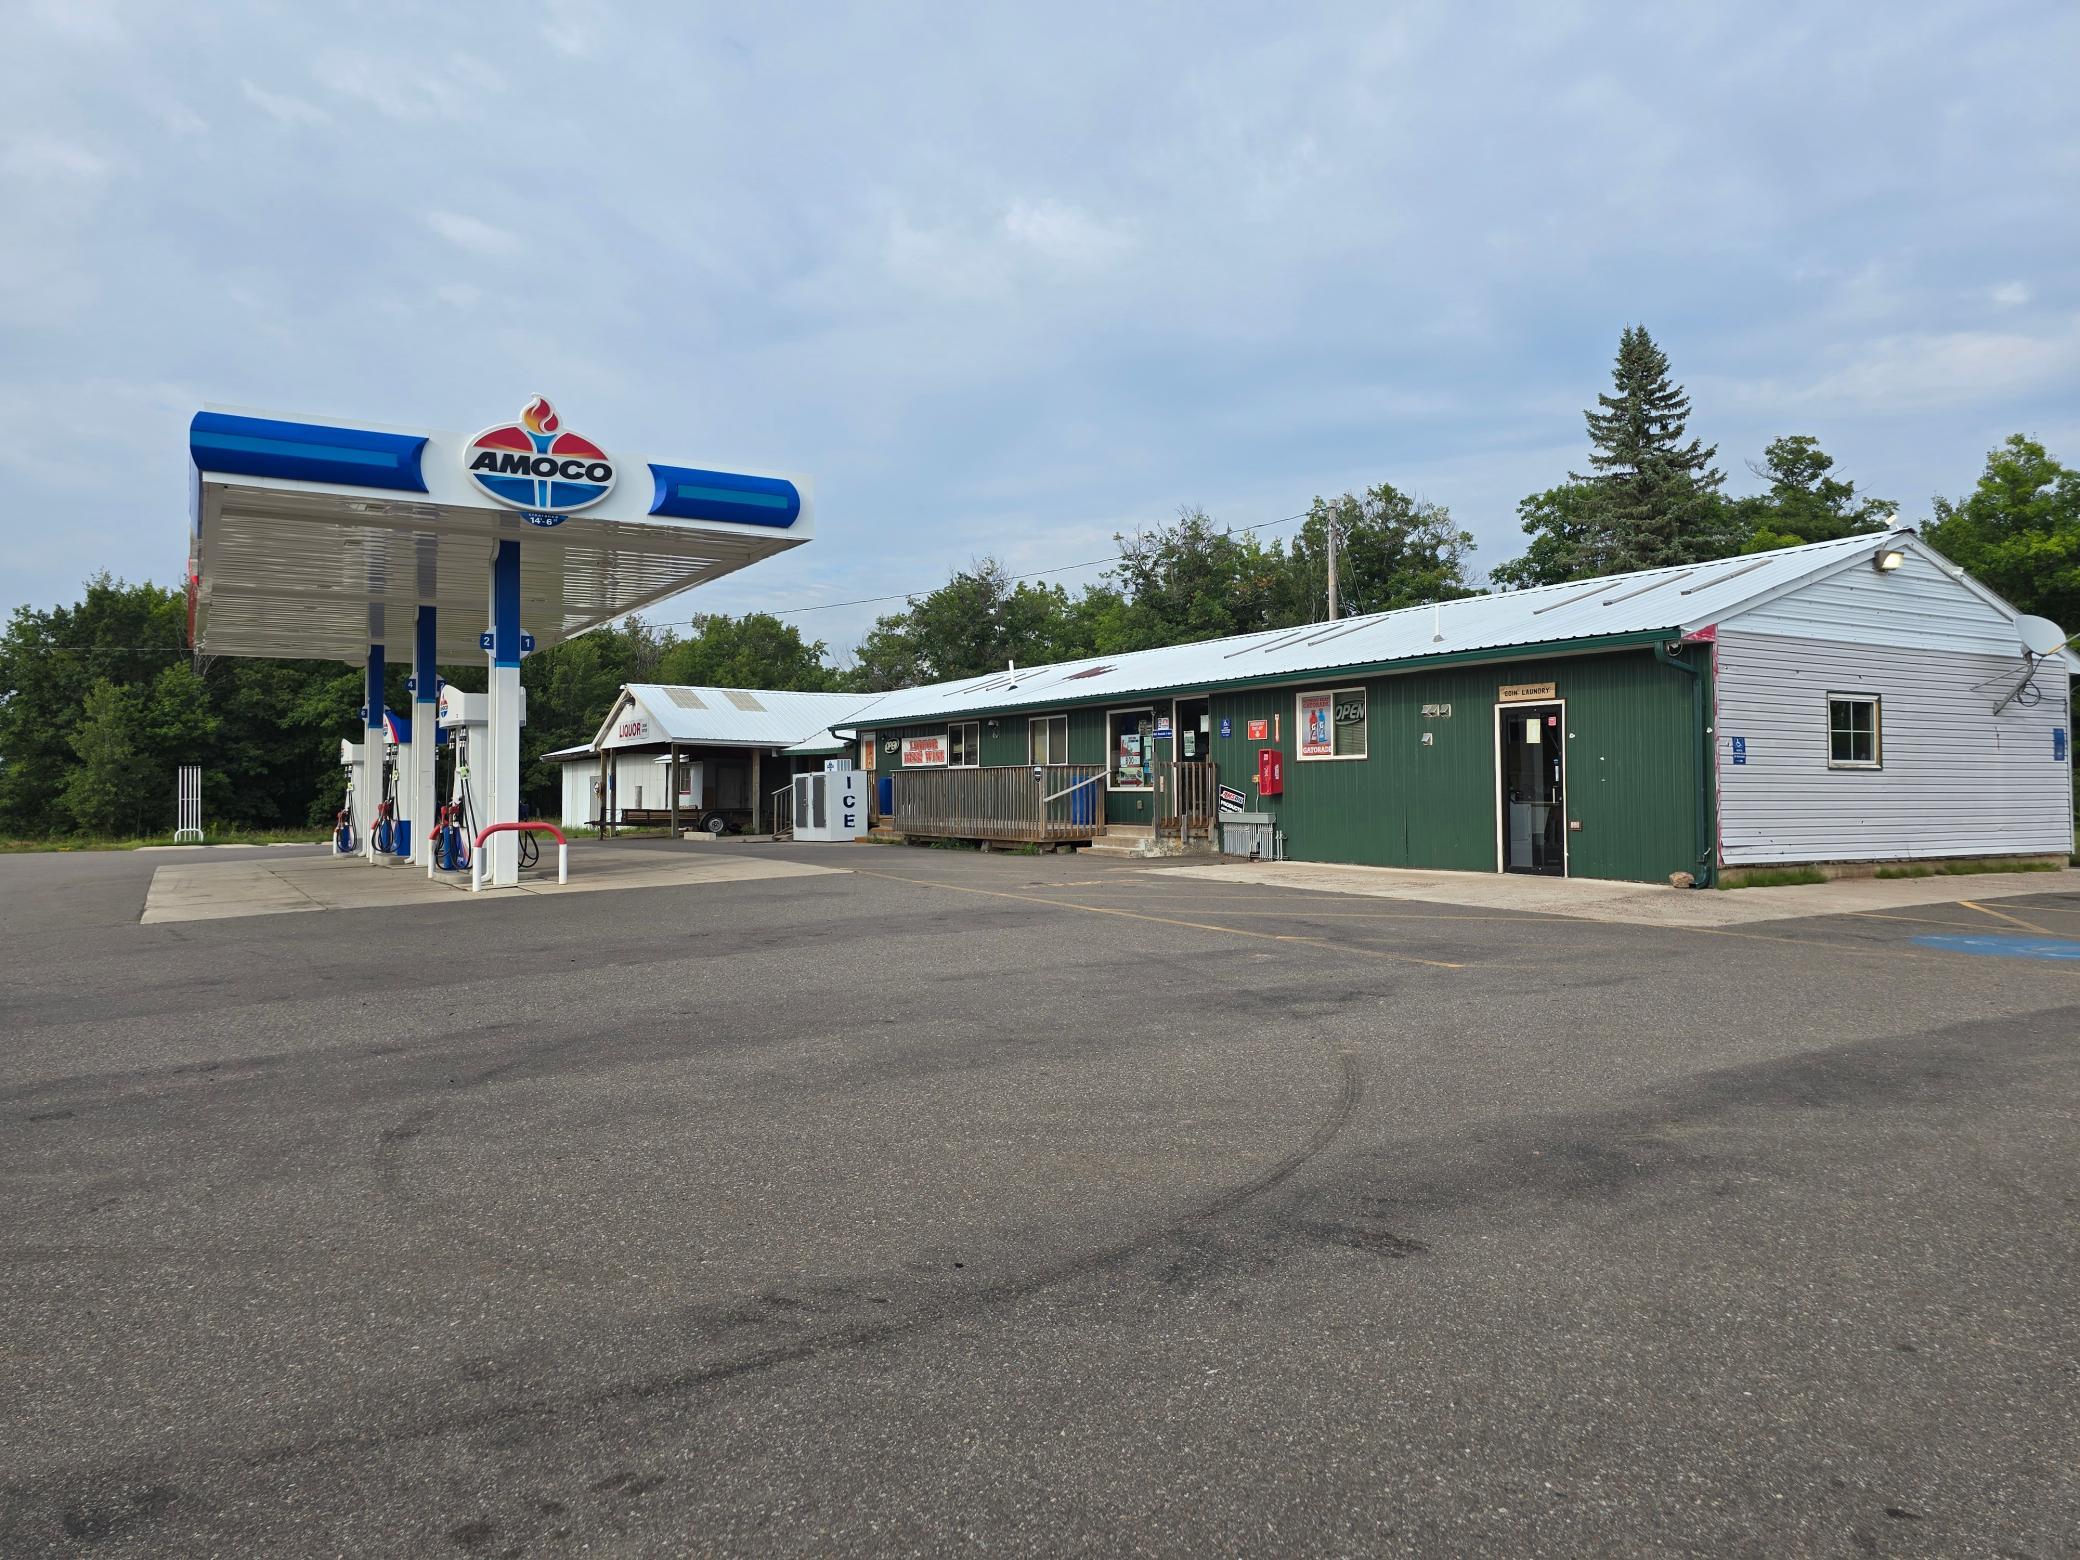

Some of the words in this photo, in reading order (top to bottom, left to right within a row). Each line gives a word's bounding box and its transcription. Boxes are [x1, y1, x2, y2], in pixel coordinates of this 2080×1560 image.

[469, 452, 612, 482] AMOCO
[483, 637, 490, 646] 2
[525, 639, 530, 647] 1
[1521, 687, 1550, 696] LAUNDRY
[1336, 703, 1365, 720] OPEN
[619, 722, 641, 738] LIQUOR
[1302, 746, 1332, 754] GATORADE
[843, 776, 856, 828] ICE
